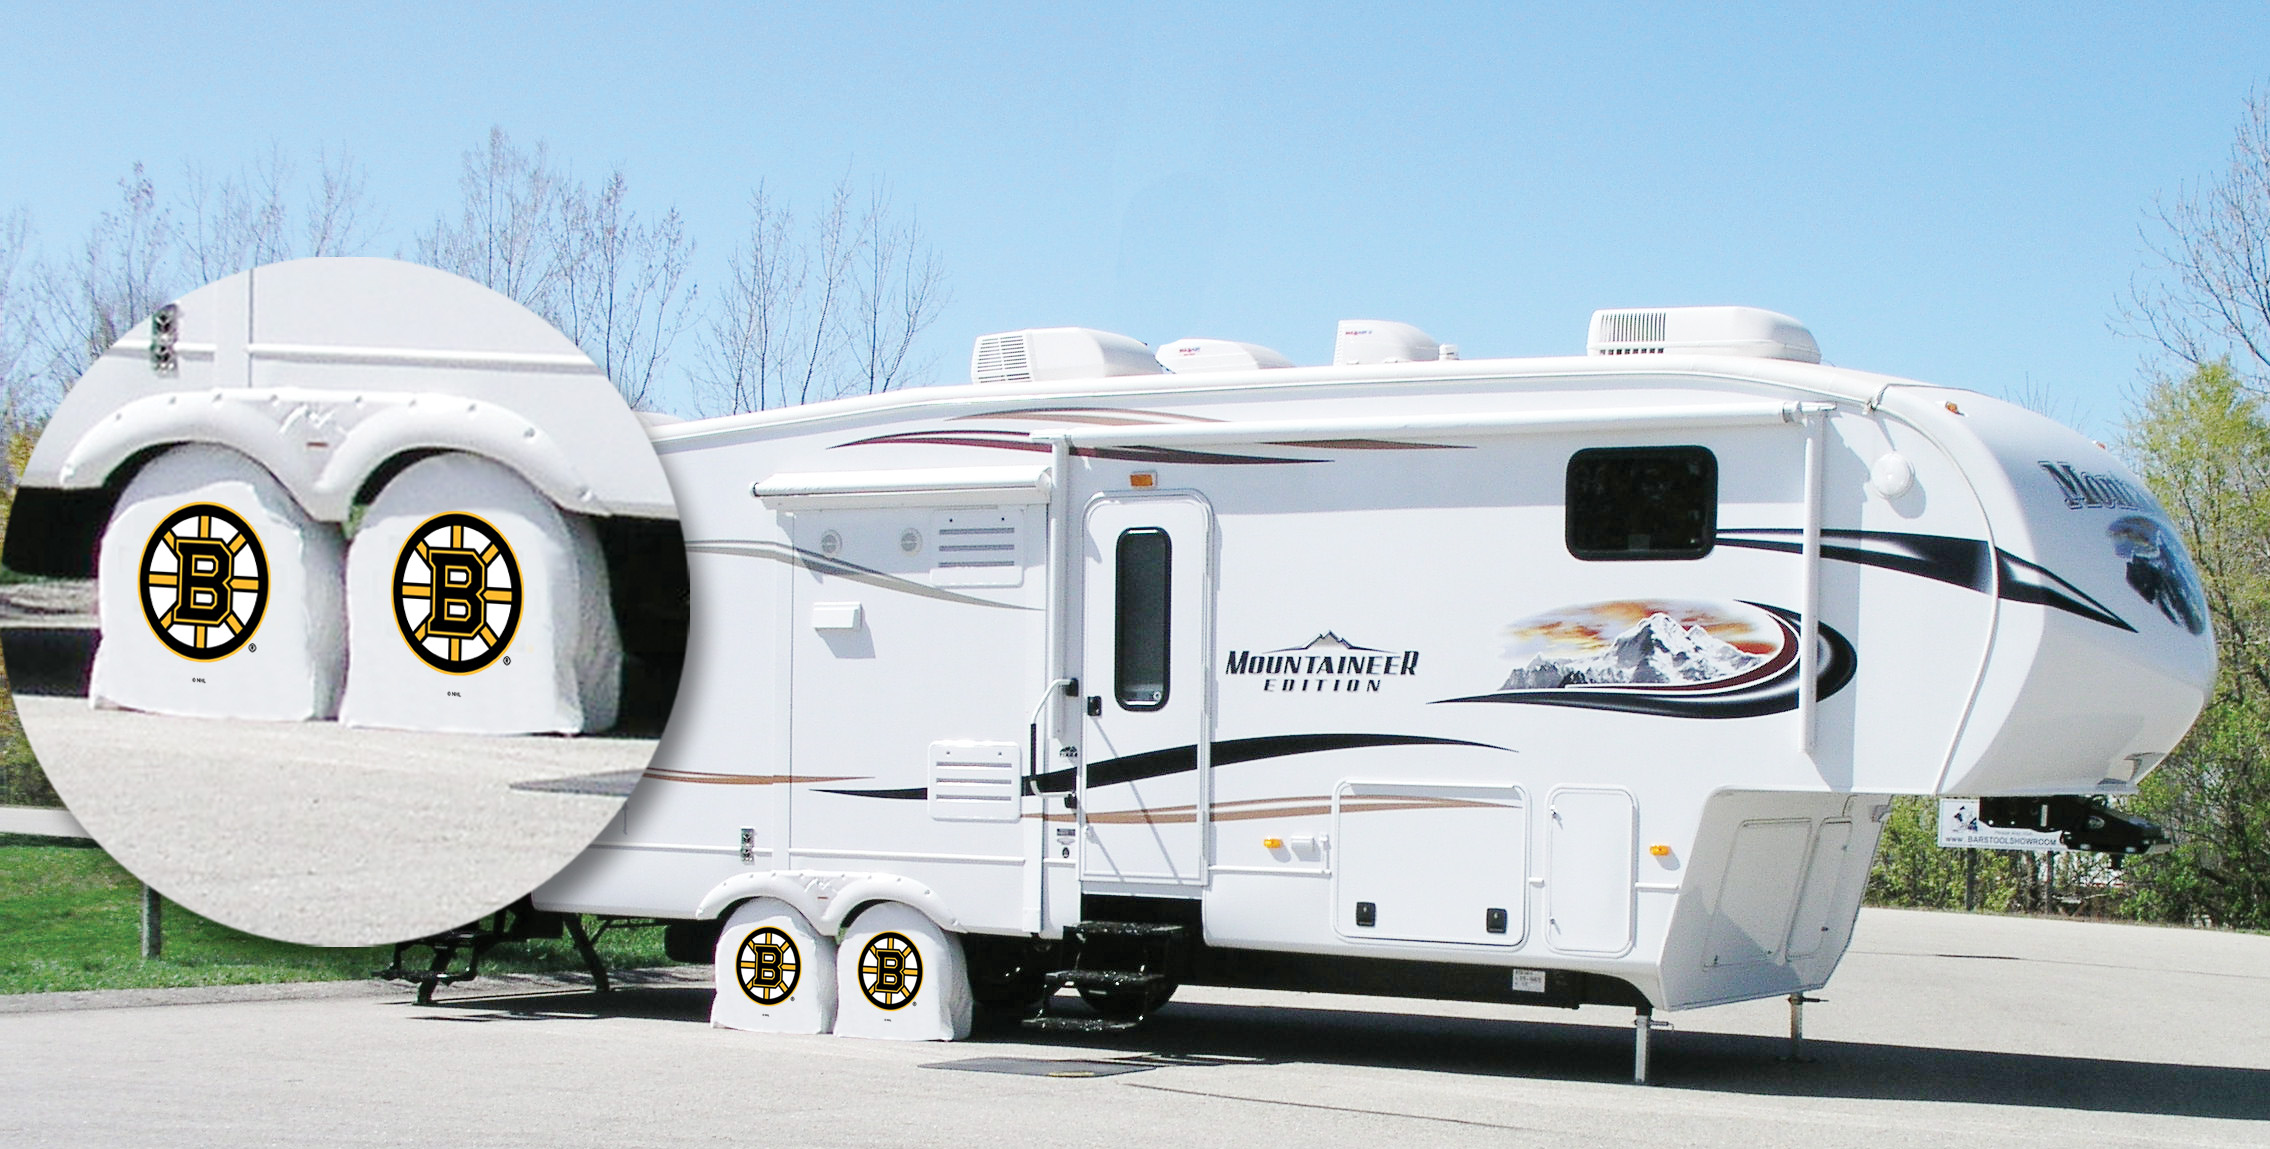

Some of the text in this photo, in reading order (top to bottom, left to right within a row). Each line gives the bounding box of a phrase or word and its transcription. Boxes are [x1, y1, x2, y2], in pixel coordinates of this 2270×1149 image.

[173, 537, 235, 627] B
[426, 547, 488, 638] B
[1225, 650, 1420, 676] MOUNTAINEER
[1263, 678, 1381, 693] EDITION
[752, 944, 784, 988] B
[874, 949, 905, 993] B
